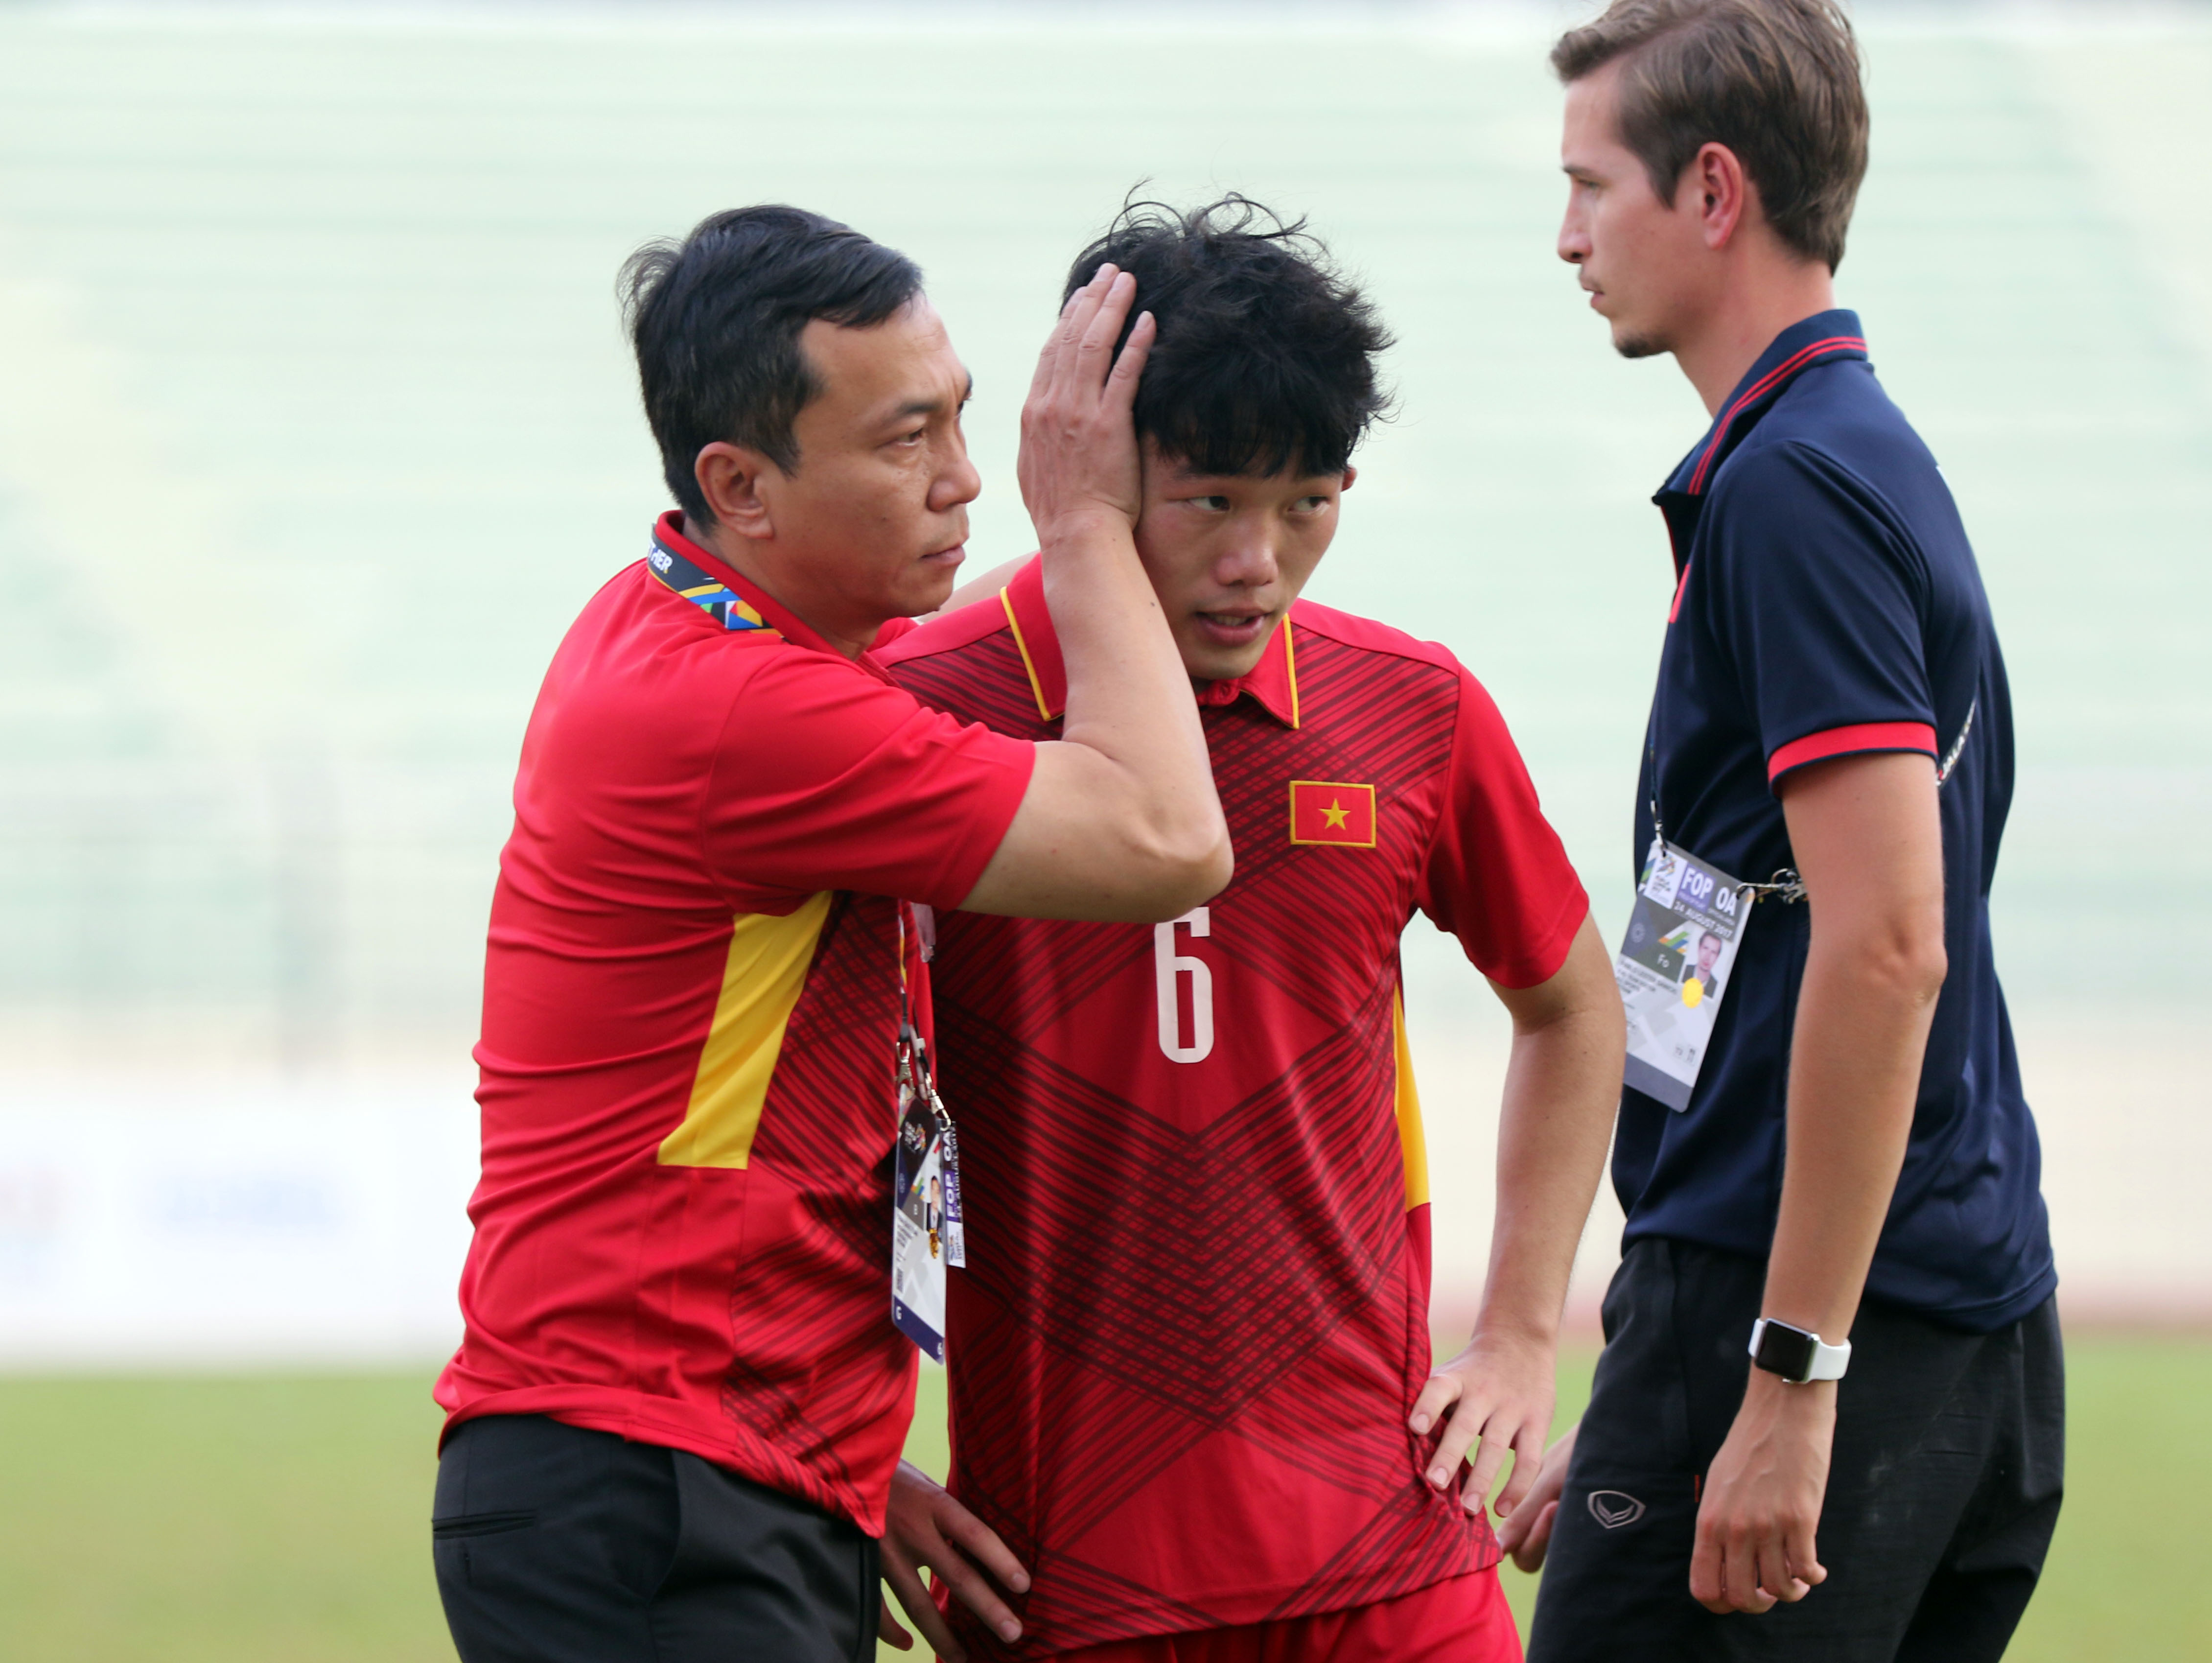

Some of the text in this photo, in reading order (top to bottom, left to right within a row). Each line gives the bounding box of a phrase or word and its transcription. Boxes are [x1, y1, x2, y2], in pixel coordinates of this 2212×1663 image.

[1681, 868, 1714, 899] FOP
[1716, 887, 1737, 916] OA
[1685, 908, 1715, 930] AUGUST
[1154, 907, 1214, 1063] 6
[943, 1131, 955, 1217] FOP OA
